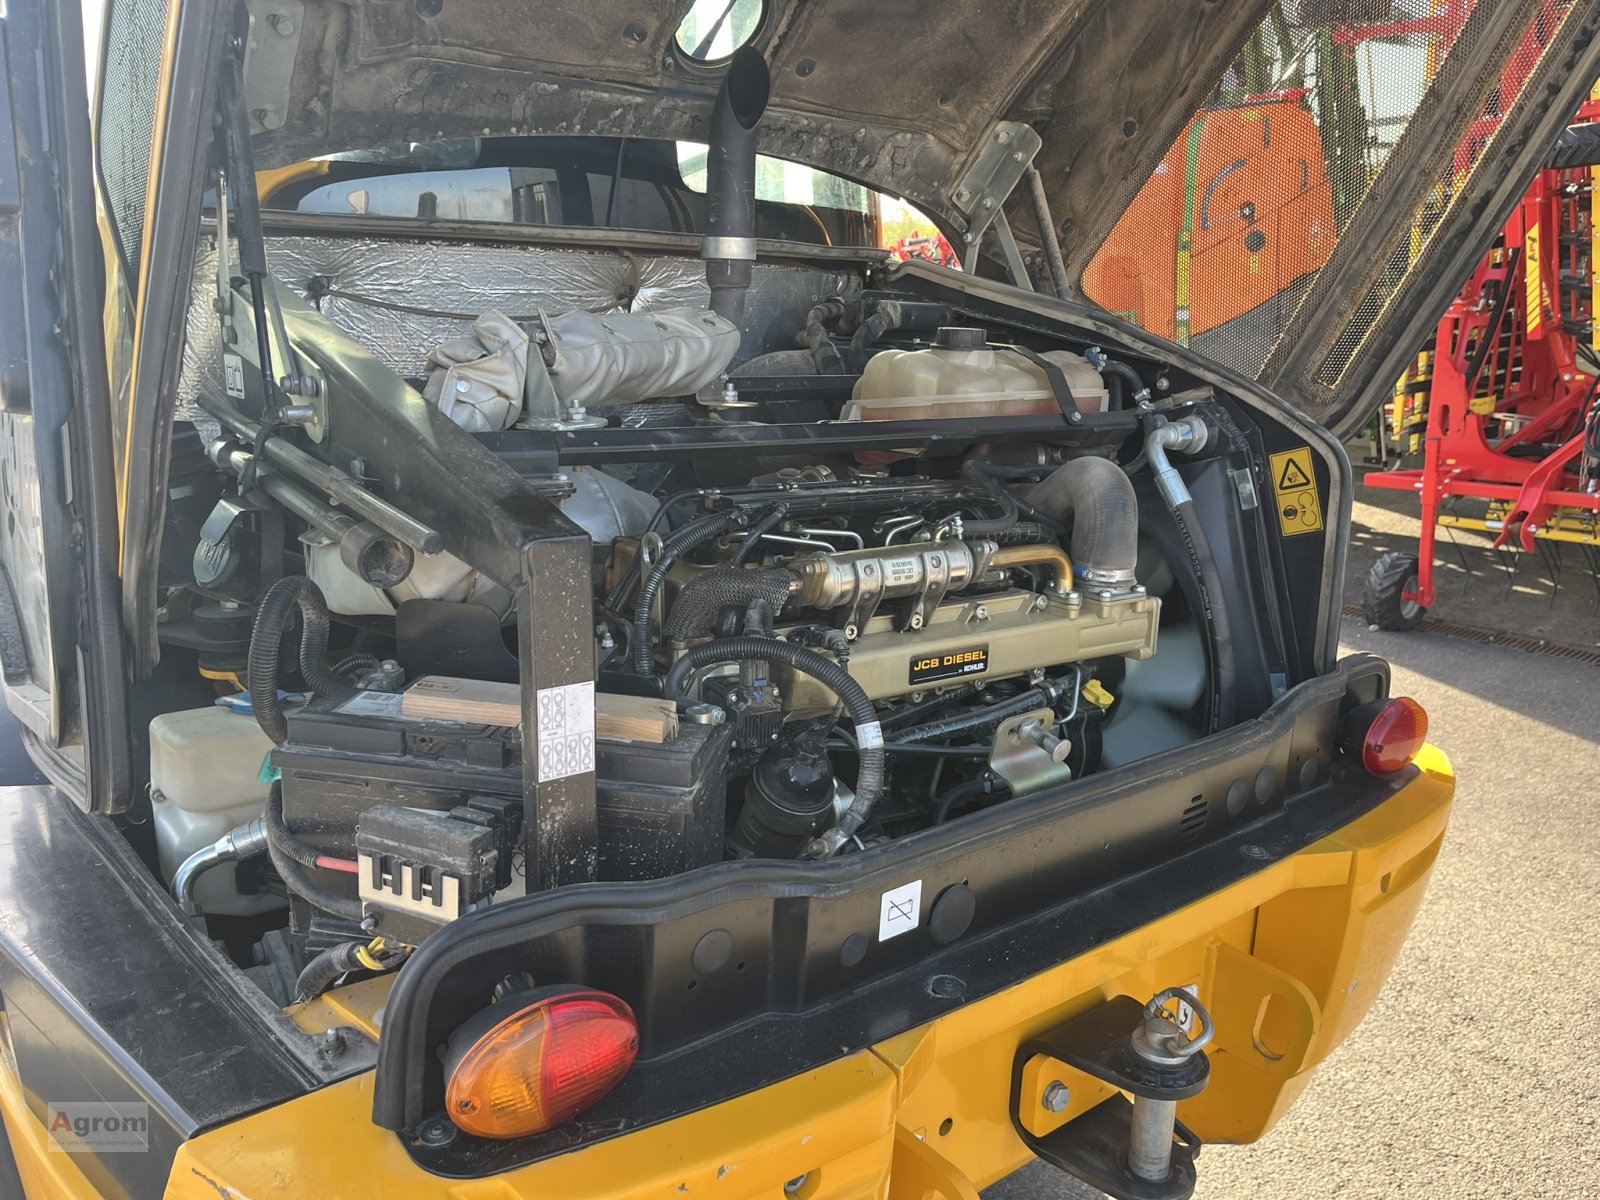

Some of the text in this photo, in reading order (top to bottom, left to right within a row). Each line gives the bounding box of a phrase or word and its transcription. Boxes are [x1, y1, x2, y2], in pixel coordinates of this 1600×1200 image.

[914, 650, 986, 671] JCB DIESEL
[963, 662, 985, 672] KOHLER
